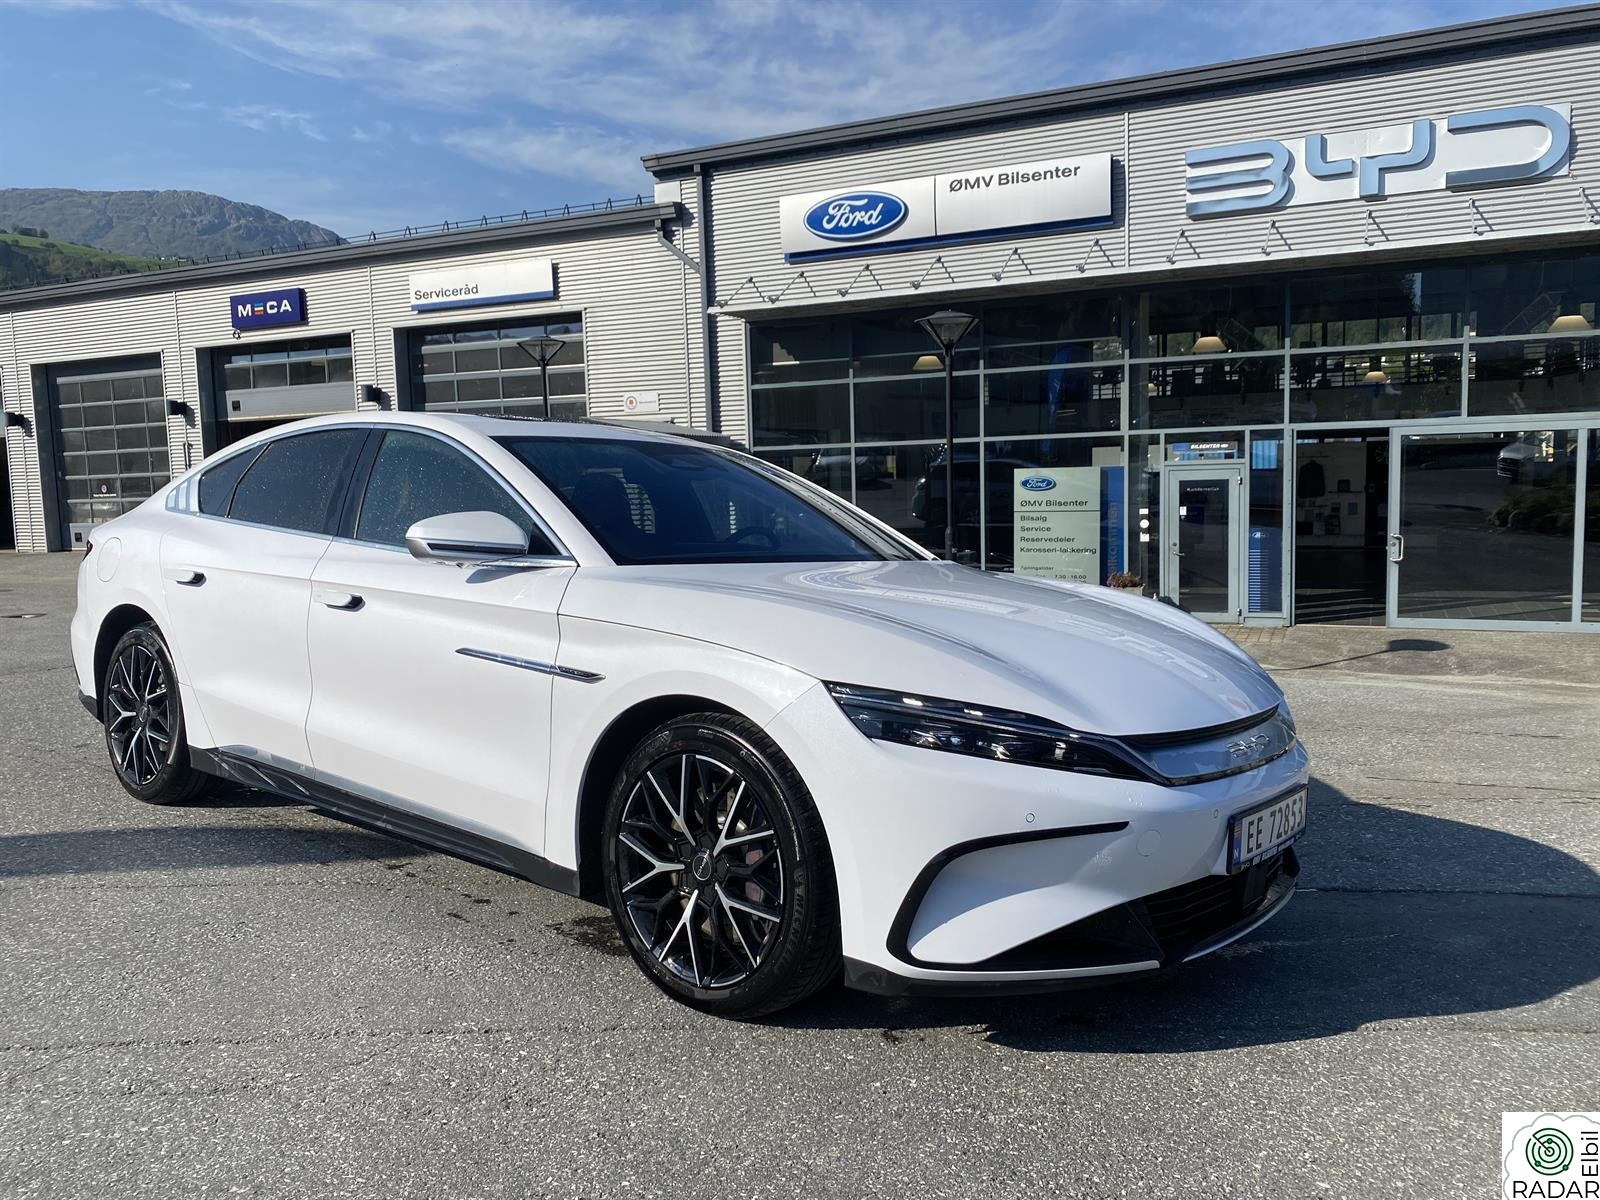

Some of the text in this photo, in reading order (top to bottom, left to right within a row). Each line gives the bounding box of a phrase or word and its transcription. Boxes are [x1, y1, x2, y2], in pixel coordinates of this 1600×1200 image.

[1185, 104, 1571, 218] BYD
[949, 165, 1081, 193] ØMV Bilsenter
[823, 198, 883, 229] Ford
[414, 283, 479, 301] Serviceråd
[237, 299, 292, 318] MECA
[1026, 478, 1048, 488] Ford
[1020, 499, 1089, 508] ØMV Bilsenter
[1020, 515, 1047, 523] Bilsalg
[1020, 525, 1052, 533] Service
[1247, 795, 1304, 854] EE 72853
